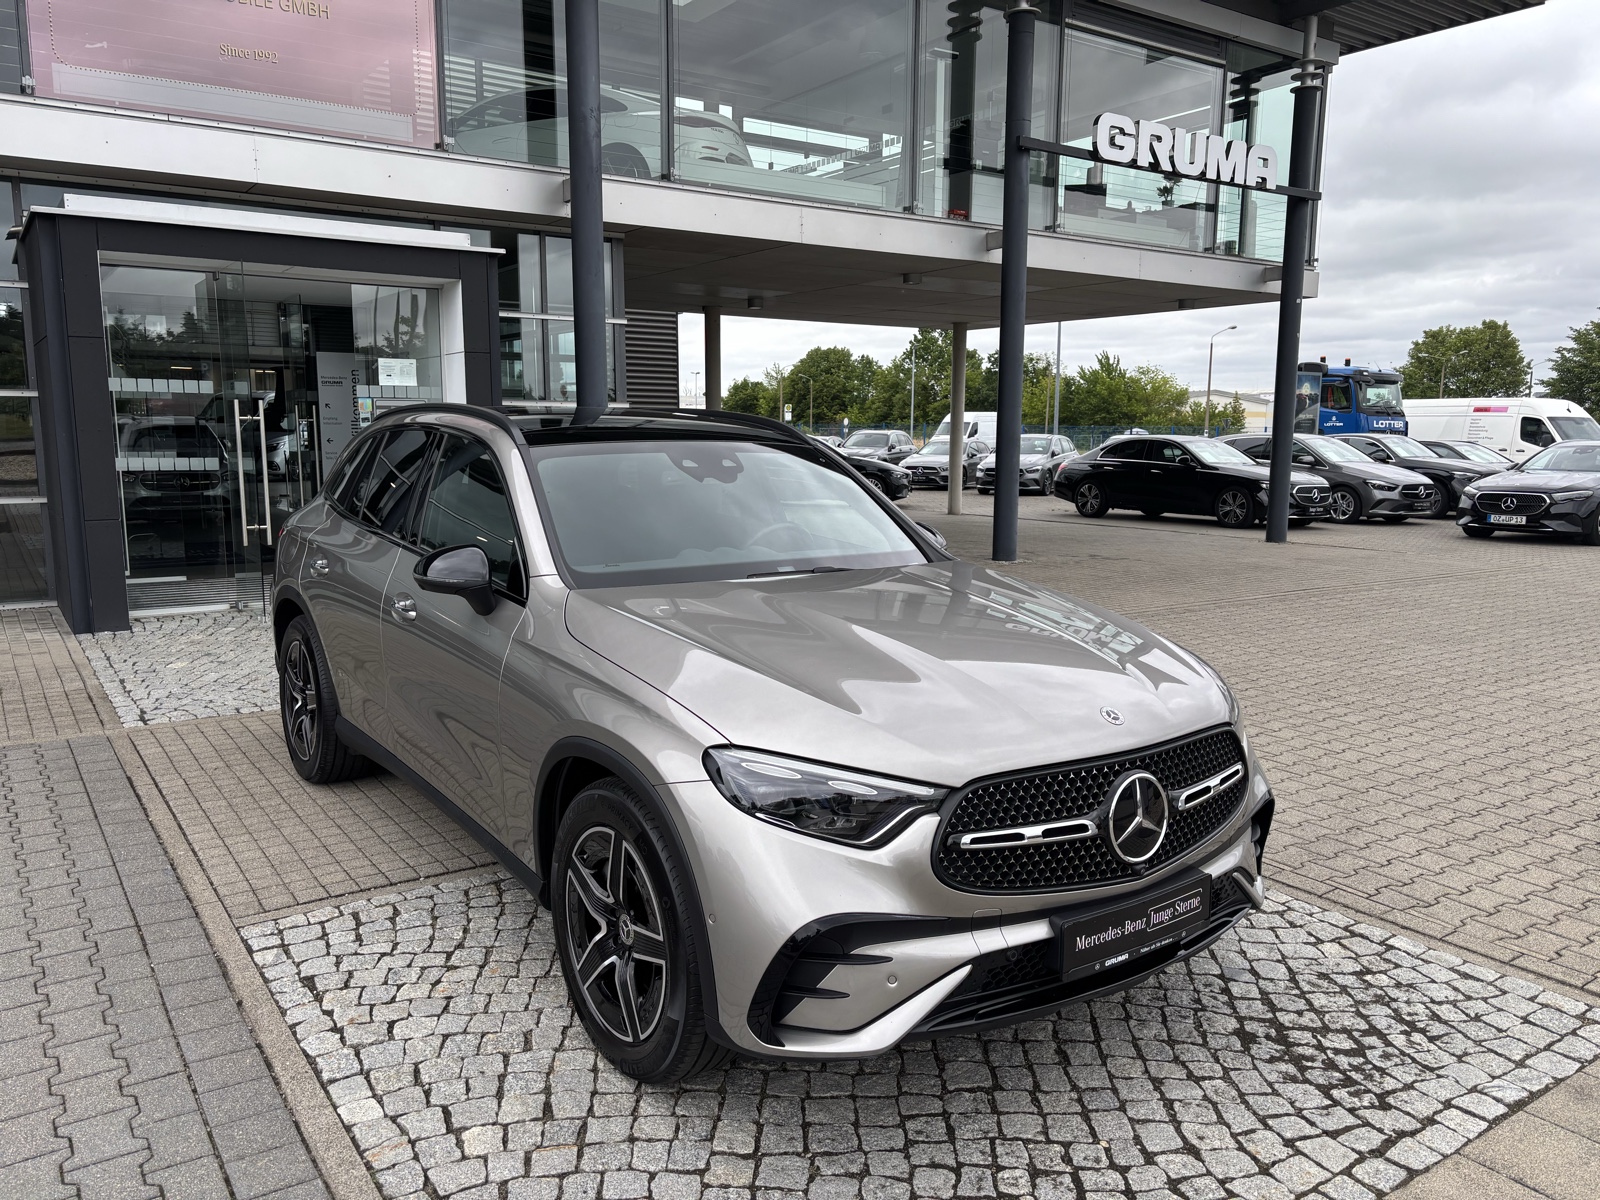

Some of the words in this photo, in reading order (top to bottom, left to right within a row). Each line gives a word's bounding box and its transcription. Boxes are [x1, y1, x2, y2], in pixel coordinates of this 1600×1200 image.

[278, 0, 331, 19] GMBH
[219, 43, 250, 59] Since
[253, 49, 279, 64] 1992
[1093, 111, 1278, 190] GRUMA
[351, 369, 361, 436] illkommen
[1373, 420, 1404, 429] LOTTER
[1492, 515, 1502, 523] OZ
[1515, 516, 1524, 524] 13
[1075, 917, 1147, 952] Mercedes-Benz
[1149, 905, 1174, 928] Junge
[1174, 895, 1201, 916] Sterne
[1104, 953, 1129, 967] GRUMA
